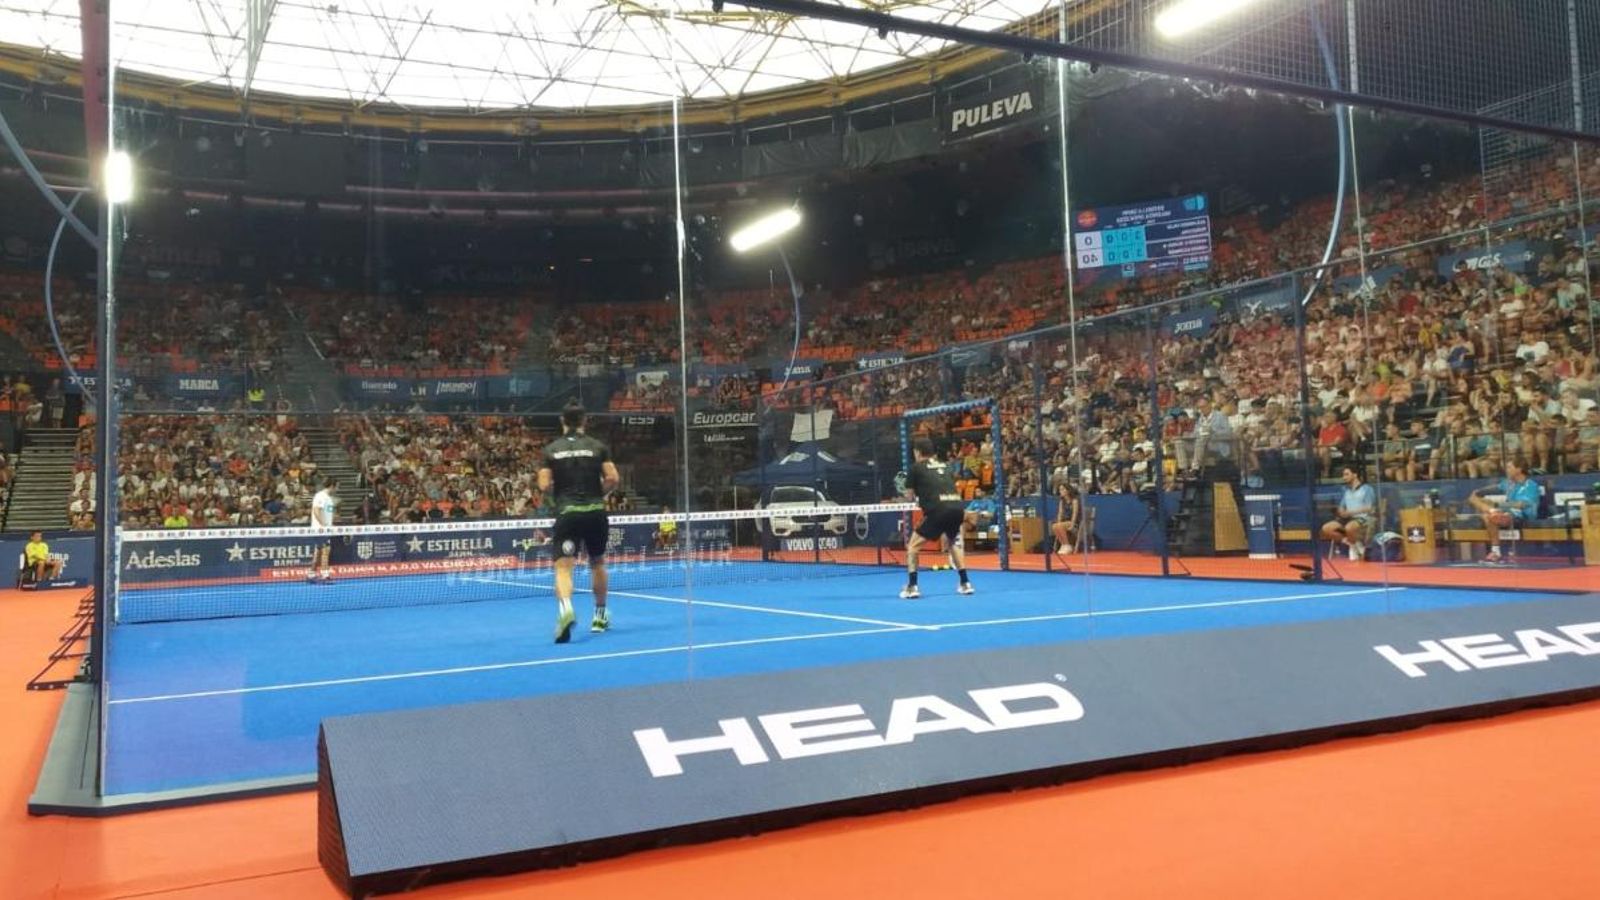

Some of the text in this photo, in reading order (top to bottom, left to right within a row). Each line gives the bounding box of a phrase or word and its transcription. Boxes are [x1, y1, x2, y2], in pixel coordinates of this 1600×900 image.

[951, 91, 1033, 132] PULEVA
[179, 379, 220, 391] MARCA
[693, 411, 756, 426] Europcar
[427, 537, 494, 552] ESTRELLA
[786, 537, 814, 551] VOLVO
[125, 549, 201, 570] Adeslas
[250, 545, 320, 560] ESTRELL
[632, 681, 1086, 778] HEAD
